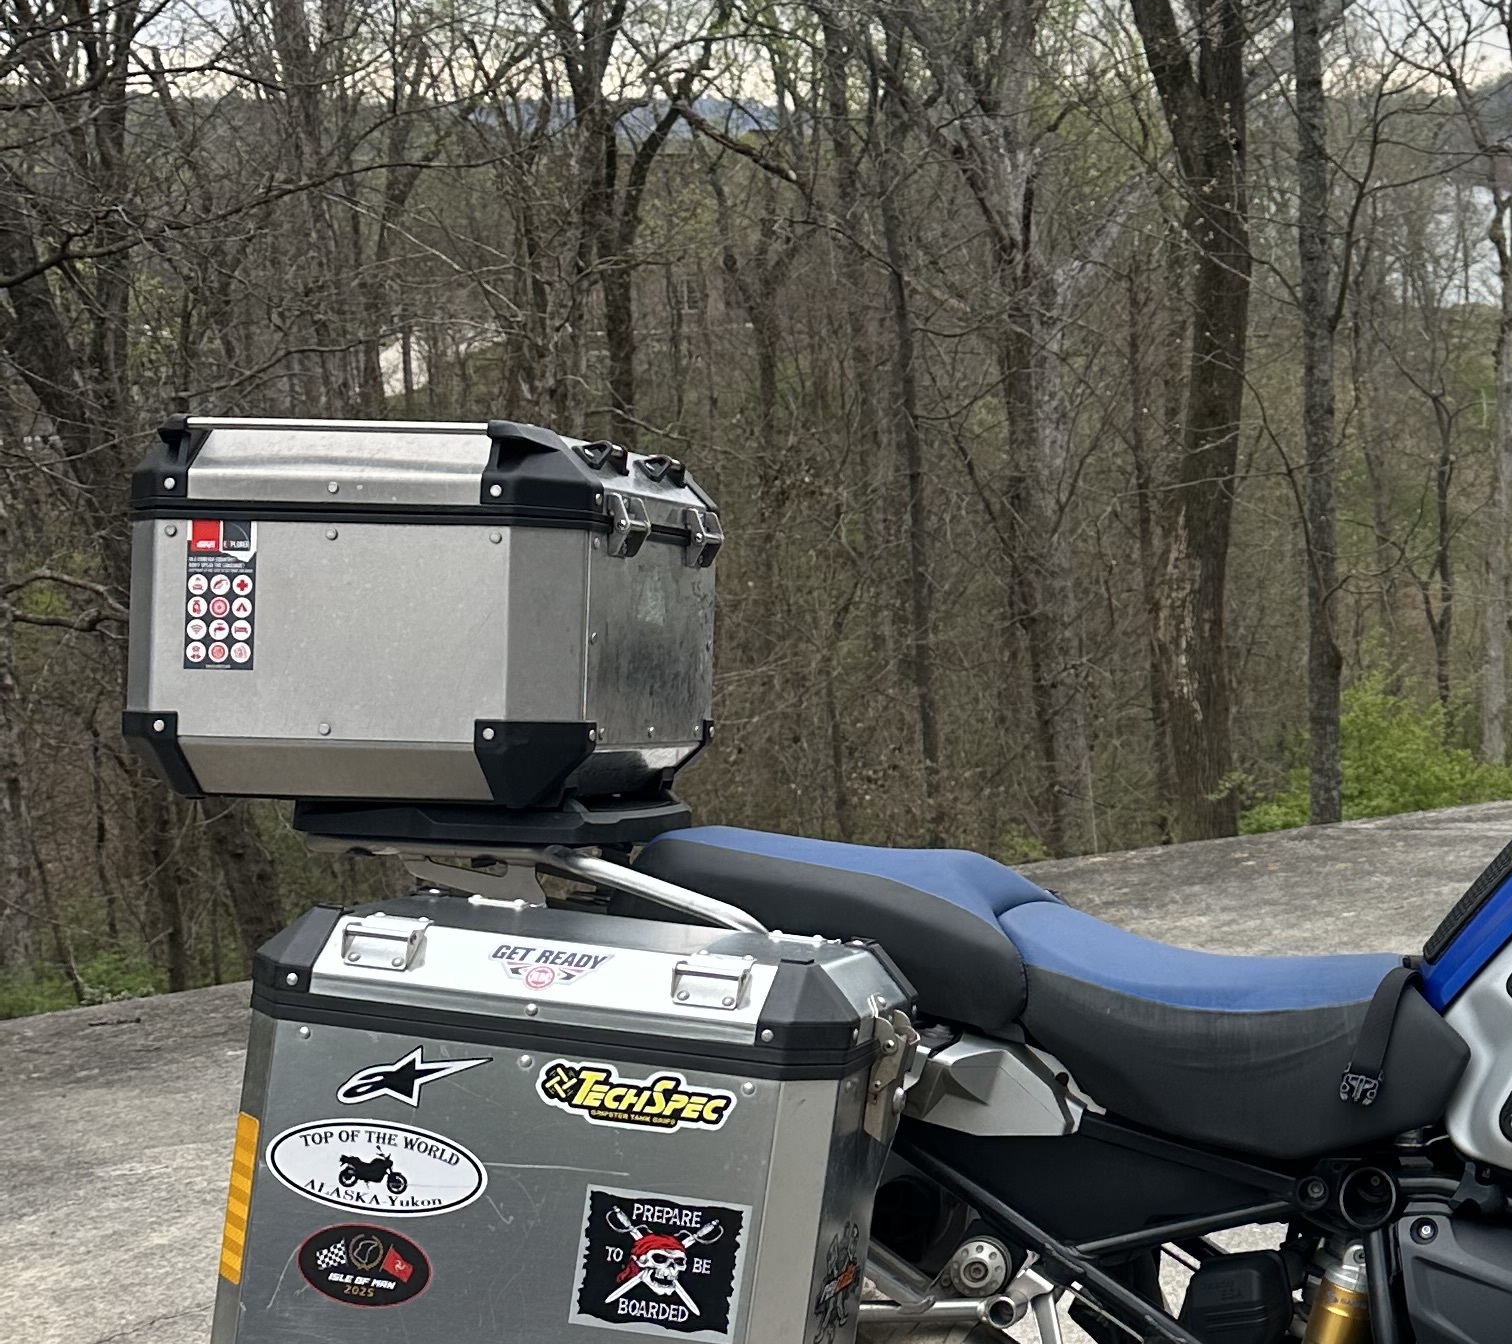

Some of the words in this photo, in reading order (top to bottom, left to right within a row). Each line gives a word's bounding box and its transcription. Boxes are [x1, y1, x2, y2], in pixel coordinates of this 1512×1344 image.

[491, 944, 536, 962] GET
[534, 949, 608, 970] READY
[300, 1131, 333, 1147] TOP
[338, 1130, 360, 1143] OF
[364, 1130, 398, 1147] THE
[403, 1136, 460, 1167] WORLD
[632, 1203, 702, 1228] PREPARE
[605, 1246, 624, 1262] TO
[692, 1257, 712, 1275] BE
[328, 1272, 354, 1284] ISLE
[353, 1275, 371, 1286] OF
[371, 1277, 397, 1290] MAN
[343, 1284, 375, 1298] 2025
[617, 1298, 689, 1323] BOARDED
